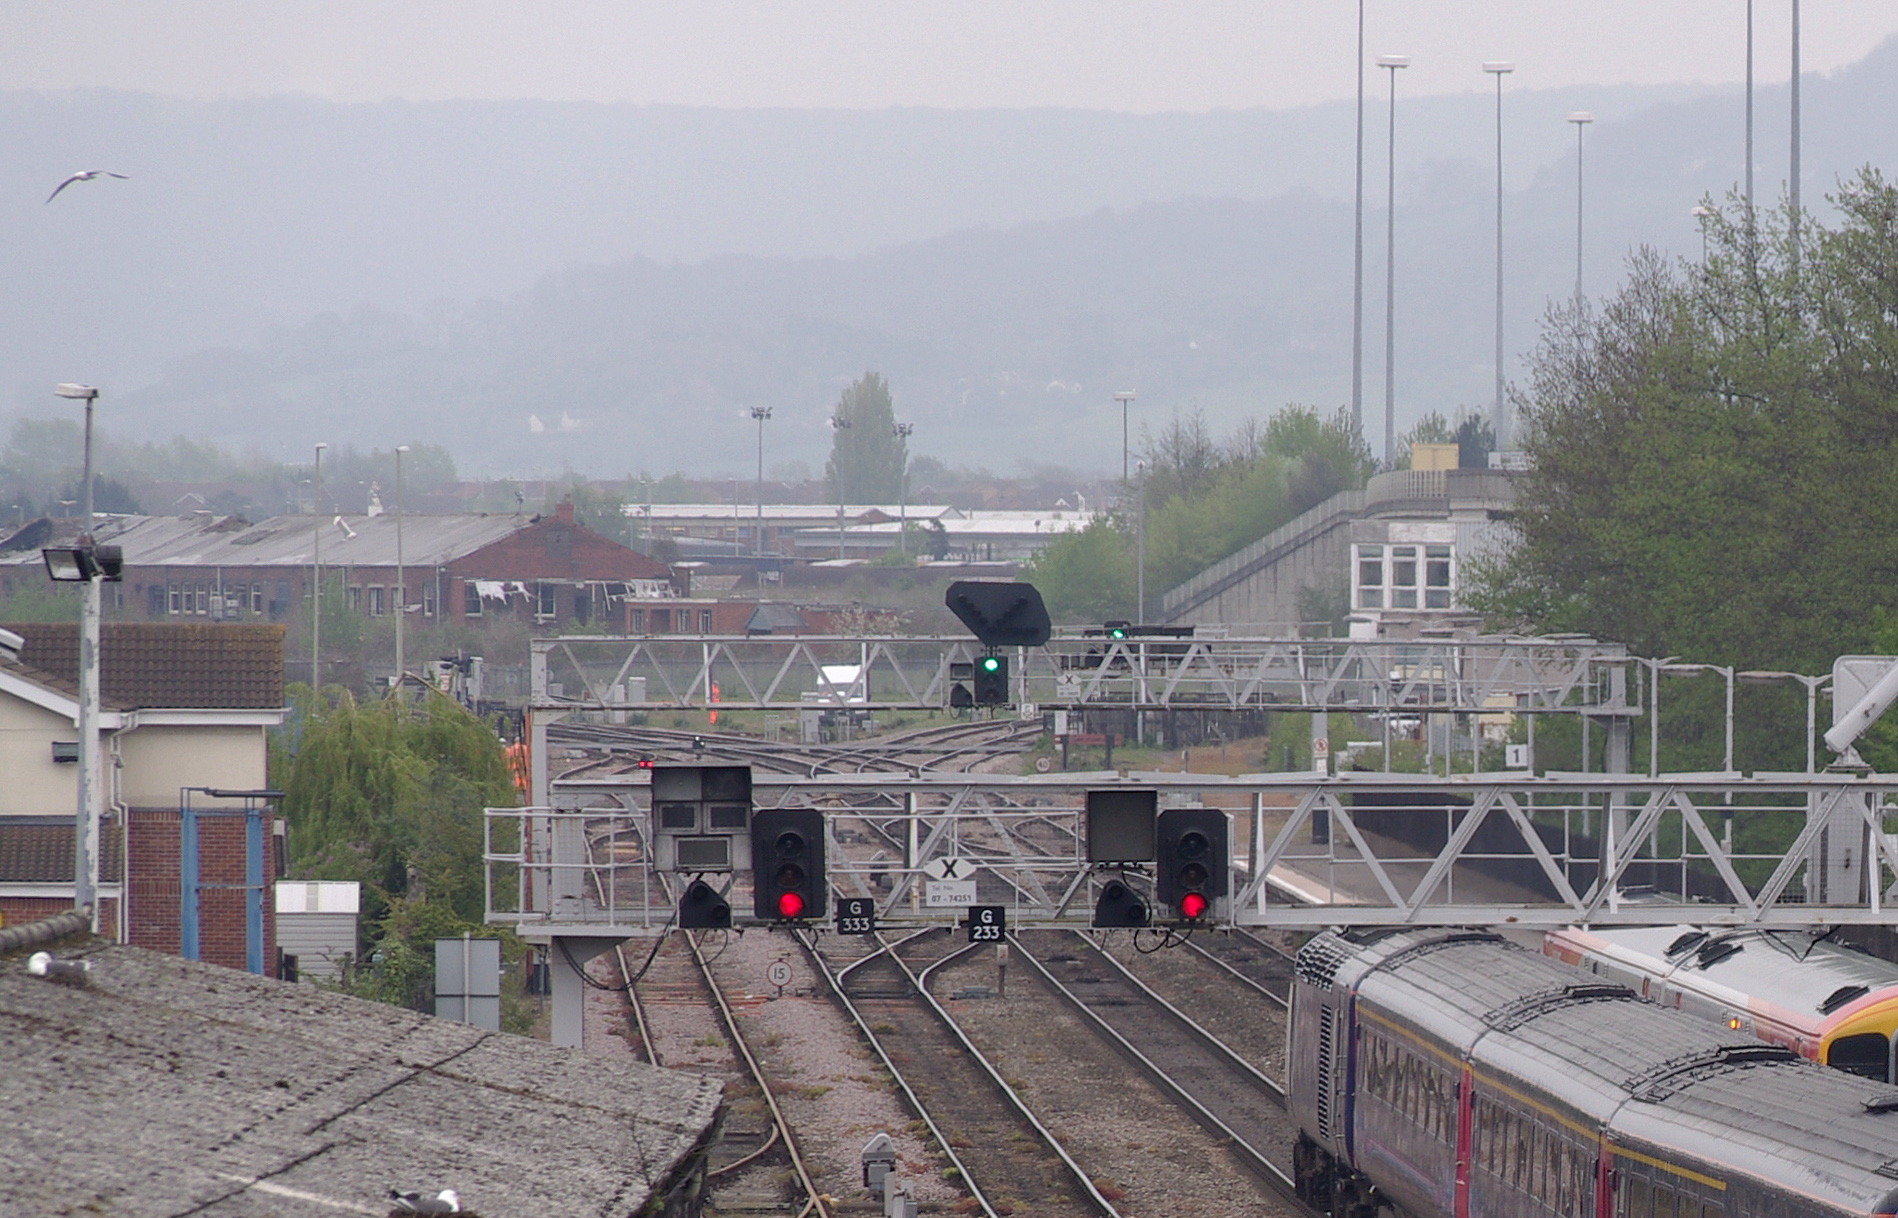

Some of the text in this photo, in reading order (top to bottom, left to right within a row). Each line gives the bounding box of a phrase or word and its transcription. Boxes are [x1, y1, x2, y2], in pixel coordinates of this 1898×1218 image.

[1512, 750, 1520, 763] 1
[941, 858, 959, 879] X
[849, 900, 863, 915] G
[980, 909, 994, 924] G
[842, 917, 871, 932] 333
[973, 926, 1001, 940] 233
[773, 967, 786, 980] 15
